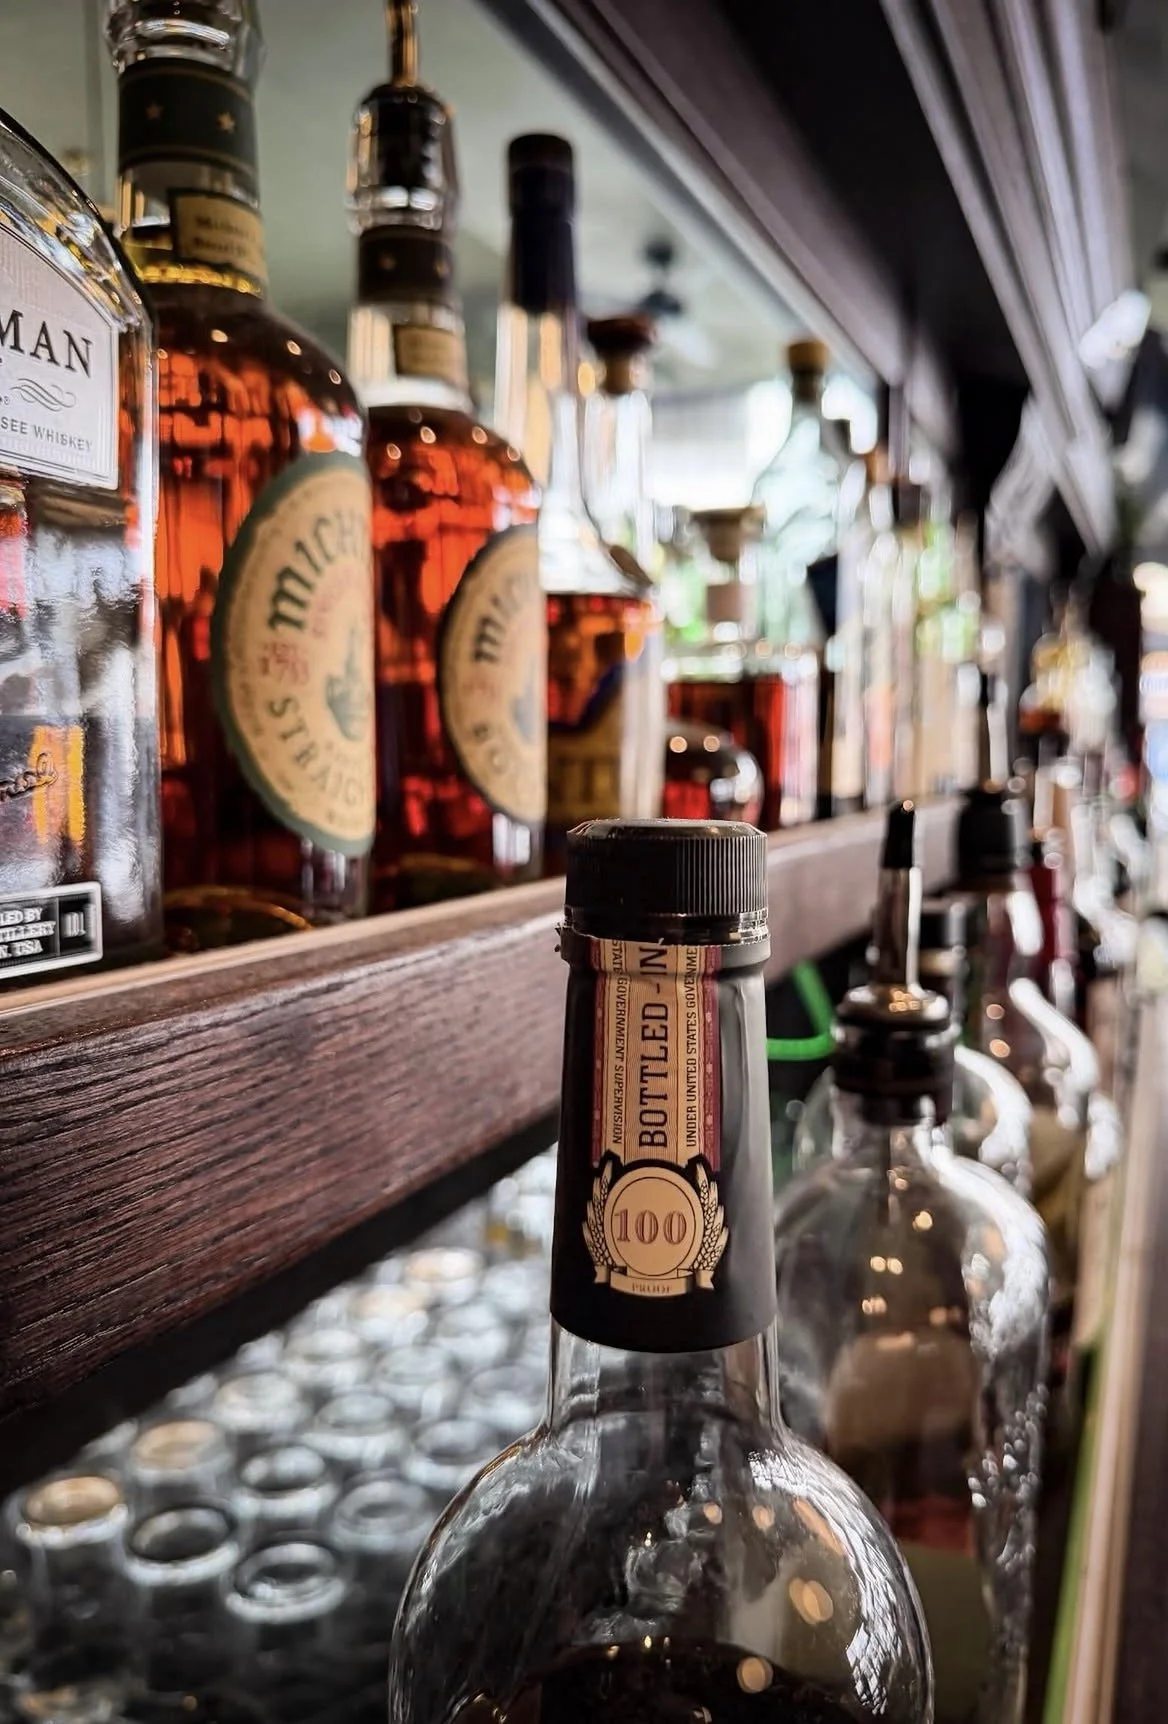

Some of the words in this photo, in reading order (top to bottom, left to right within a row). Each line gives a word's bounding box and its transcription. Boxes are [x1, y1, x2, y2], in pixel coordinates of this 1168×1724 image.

[33, 424, 93, 452] WHISKEY
[615, 977, 630, 1062] GOVERNMENT
[686, 1011, 698, 1054] STATES
[638, 1001, 669, 1149] BOTTLED
[686, 1057, 697, 1101] UNITED
[612, 1064, 626, 1144] SUPERVISION
[686, 1105, 697, 1147] UNDER
[614, 1207, 687, 1245] 100
